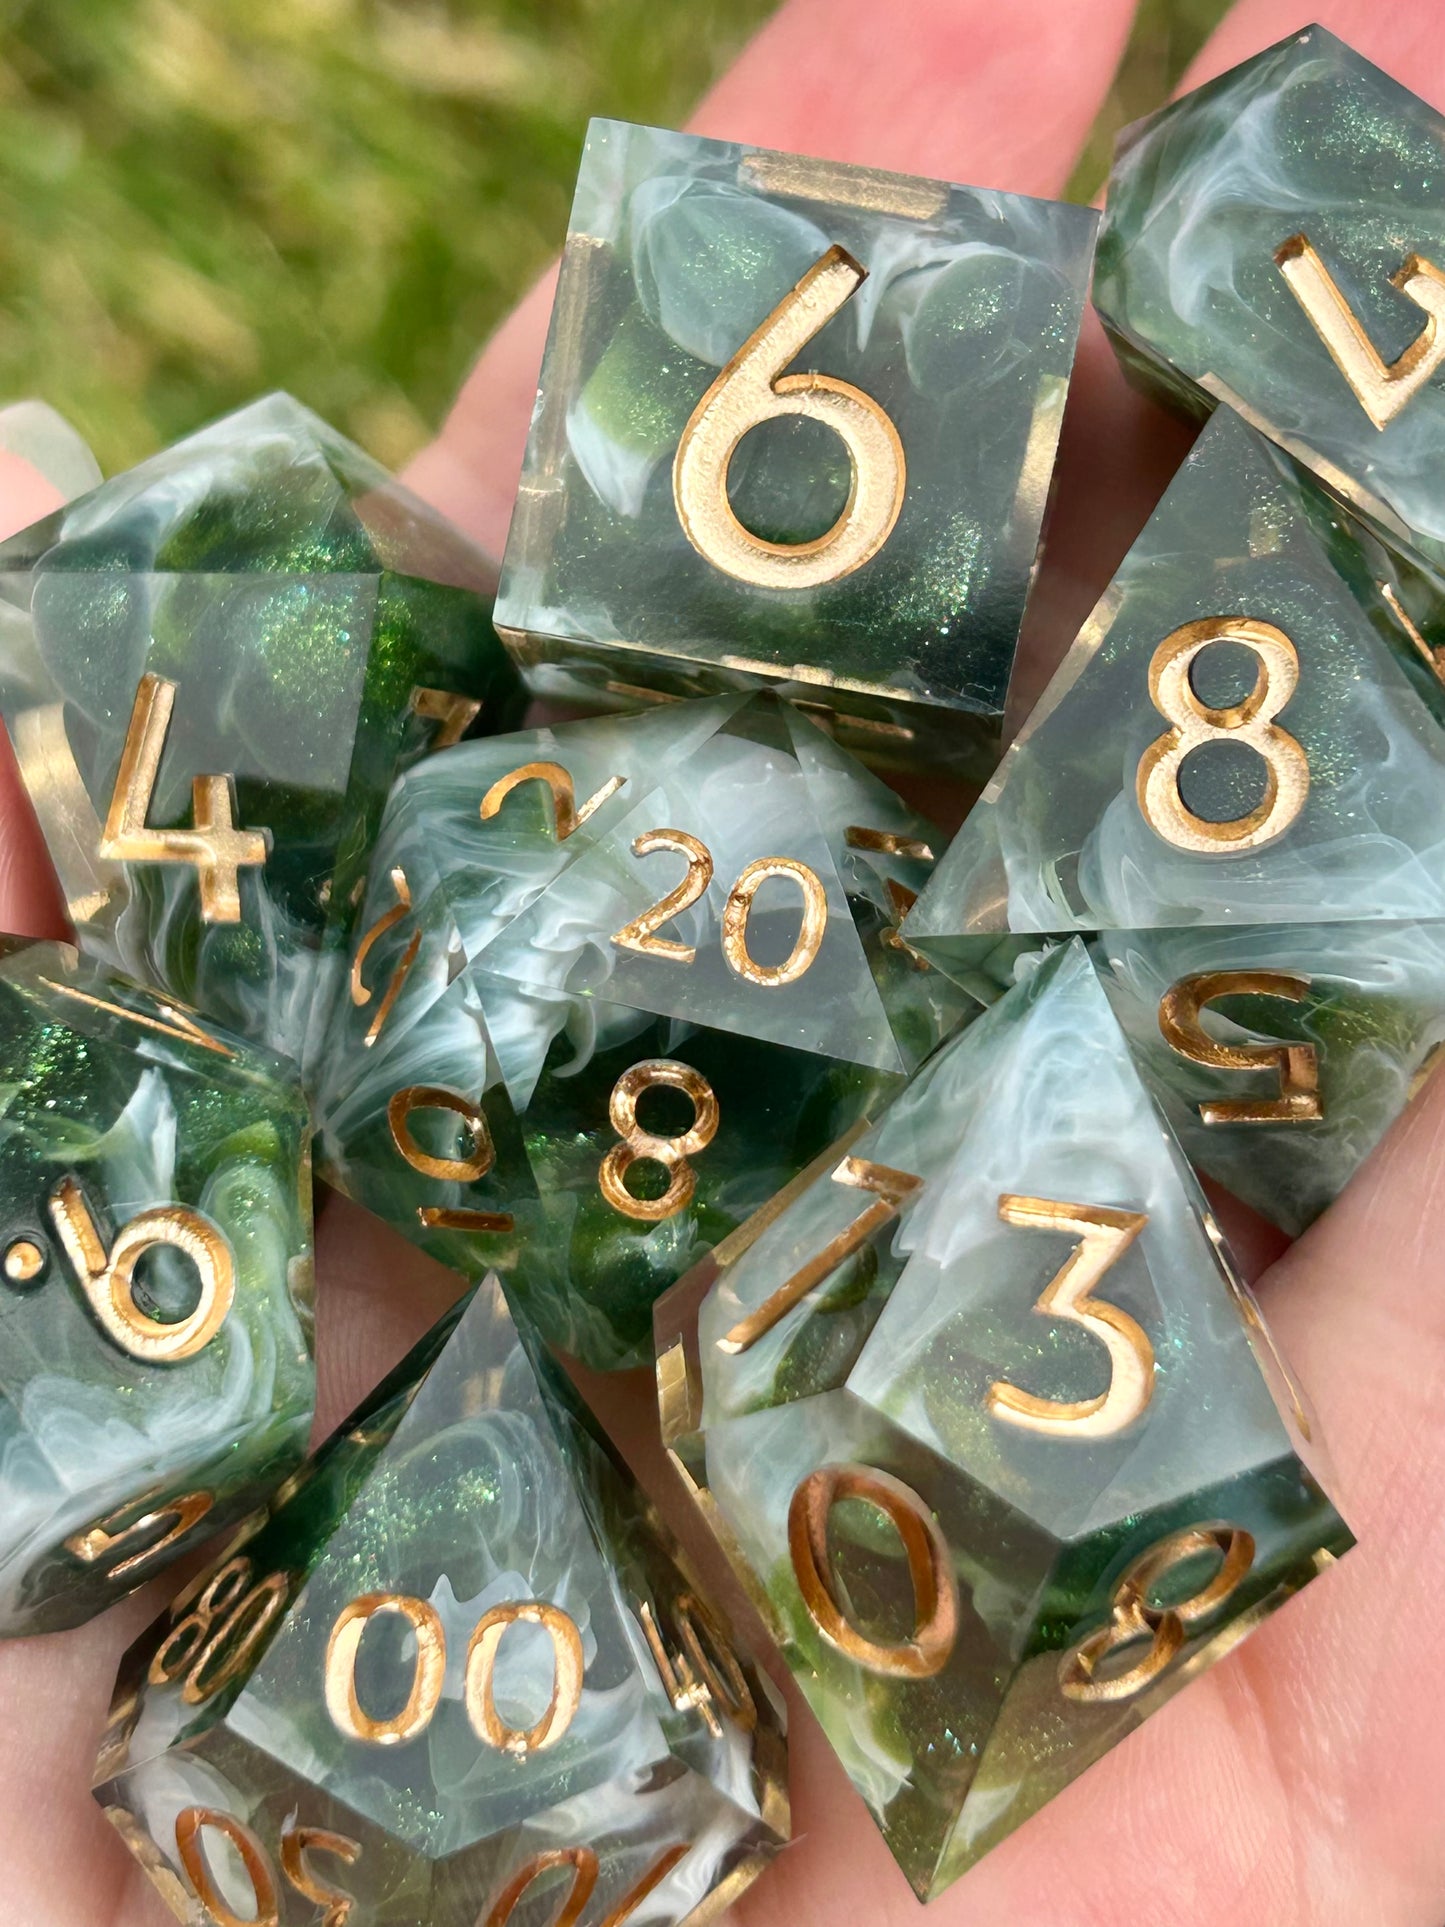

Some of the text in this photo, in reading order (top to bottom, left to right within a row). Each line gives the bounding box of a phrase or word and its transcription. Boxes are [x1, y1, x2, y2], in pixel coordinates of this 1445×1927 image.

[672, 244, 907, 590] 6
[100, 671, 274, 924] 4
[1136, 615, 1311, 857] 8
[610, 828, 828, 987] 20
[1158, 969, 1324, 1125] 5
[599, 1058, 720, 1221] 8
[984, 1193, 1150, 1439] 3
[147, 1555, 290, 1707] 80
[787, 1462, 958, 1678] 0
[1057, 1519, 1256, 1700] 8
[324, 1590, 584, 1760] 00
